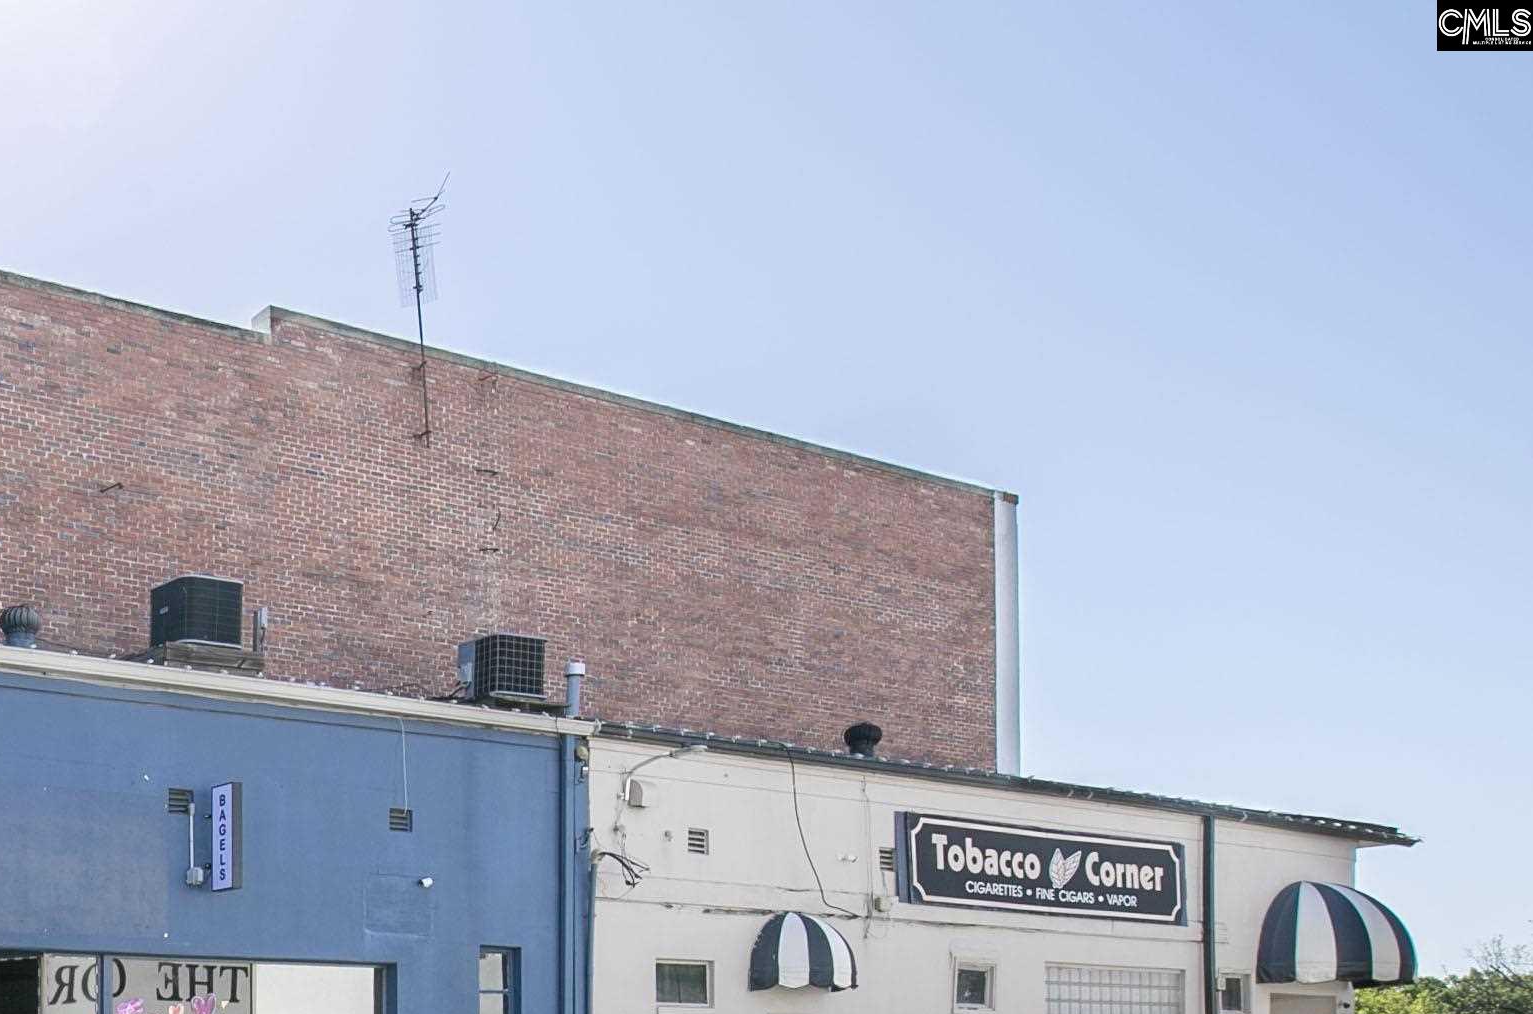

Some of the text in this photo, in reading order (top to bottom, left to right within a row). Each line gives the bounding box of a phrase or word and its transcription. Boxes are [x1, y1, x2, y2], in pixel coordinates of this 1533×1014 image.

[218, 794, 227, 881] BAGELS
[931, 833, 1164, 892] Tobacco Corner
[965, 880, 1137, 907] CIGARETTES FINE CIGARS VAPOR
